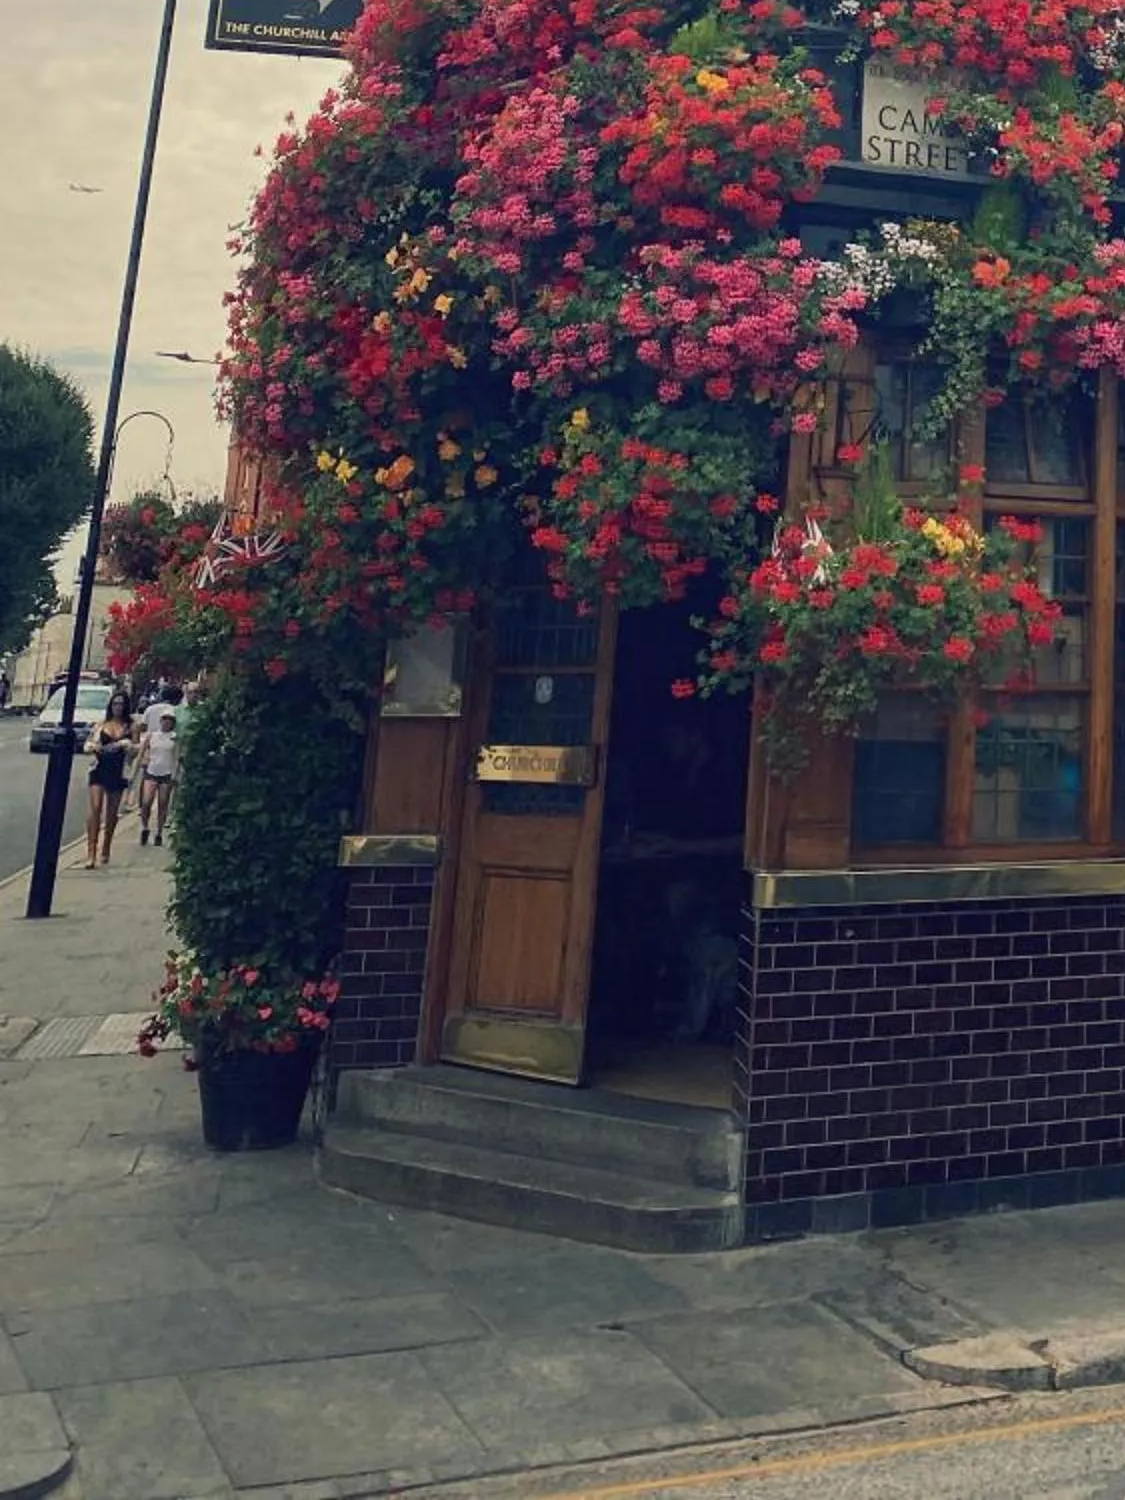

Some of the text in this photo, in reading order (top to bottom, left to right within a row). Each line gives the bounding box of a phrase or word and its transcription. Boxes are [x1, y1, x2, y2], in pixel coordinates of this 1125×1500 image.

[225, 21, 251, 35] THE
[253, 24, 327, 41] CHURCHILL
[867, 135, 958, 171] STREE
